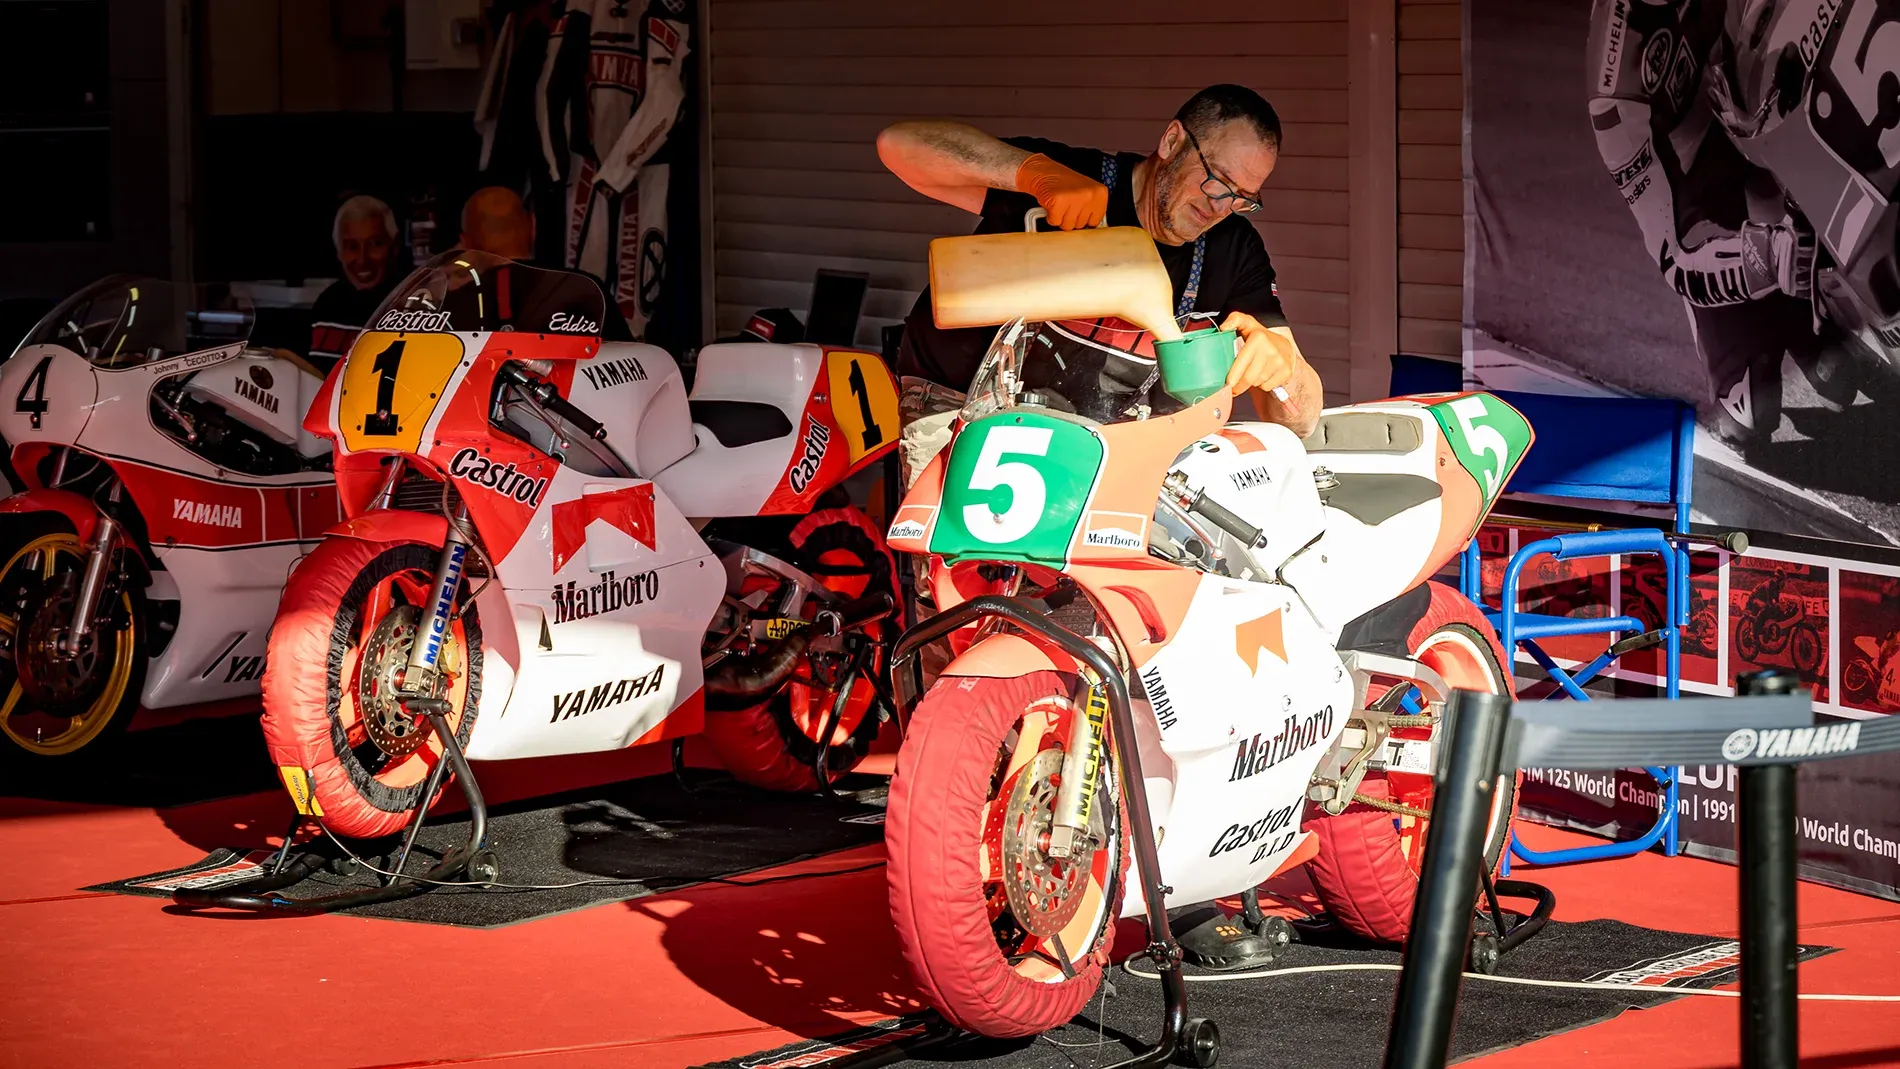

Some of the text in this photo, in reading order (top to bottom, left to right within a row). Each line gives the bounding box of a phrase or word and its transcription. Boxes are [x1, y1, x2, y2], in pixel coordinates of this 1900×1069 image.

[375, 308, 450, 332] Castrol
[548, 311, 600, 333] Eddie
[153, 352, 222, 375] Johnny CECOTTO
[363, 340, 407, 436] 1
[581, 356, 649, 391] YAMAHA
[15, 354, 54, 431] 4
[234, 375, 280, 415] YAMAHA
[849, 358, 883, 452] 1
[790, 411, 830, 496] Castrol
[1446, 396, 1508, 500] 5
[449, 446, 549, 509] Castrol
[963, 426, 1054, 544] 5
[1229, 465, 1273, 491] YAMAHA
[172, 498, 243, 529] YAMAHA
[888, 526, 923, 538] Marlboro
[1086, 532, 1141, 548] Marlboro
[423, 545, 466, 666] MICHELIN
[550, 569, 660, 625] Marlboro
[549, 664, 666, 724] YAMAHA
[1143, 666, 1178, 731] YAMAHA
[1228, 704, 1334, 782] Marlboro
[1755, 722, 1862, 758] YAMAHA
[1547, 767, 1571, 790] 125
[1573, 771, 1616, 799] World
[1702, 798, 1736, 823] 1991
[1208, 794, 1305, 858] Castrol
[1249, 831, 1296, 866] D.I.D
[1803, 817, 1850, 847] World
